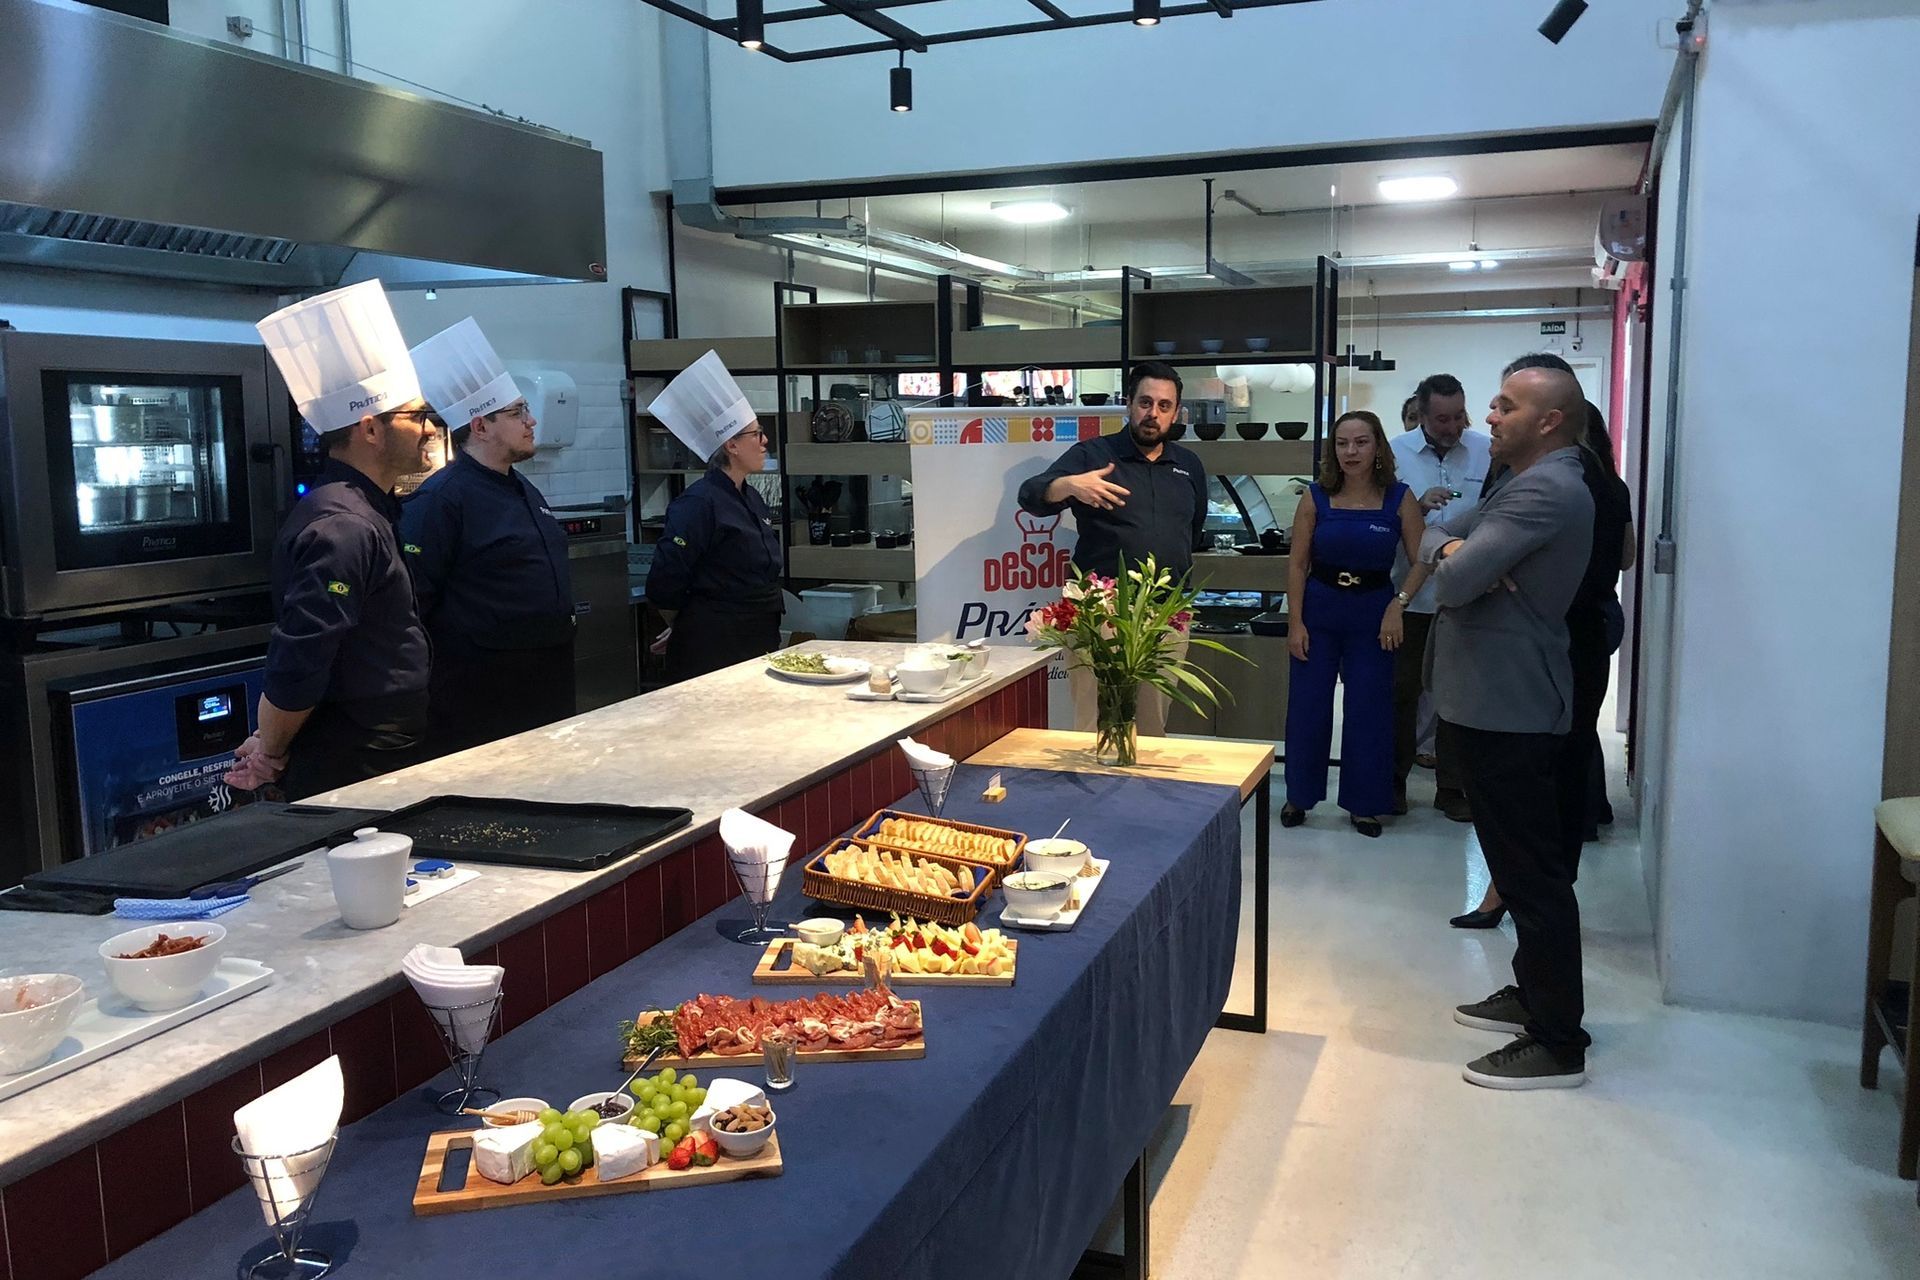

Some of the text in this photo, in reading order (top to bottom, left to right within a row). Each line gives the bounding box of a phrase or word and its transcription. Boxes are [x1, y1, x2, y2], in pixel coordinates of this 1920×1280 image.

[1541, 324, 1565, 333] SAÍDA
[158, 768, 202, 785] CONGELE,
[145, 780, 192, 801] APROVEITE
[194, 779, 201, 788] O
[203, 773, 225, 785] SISTE
